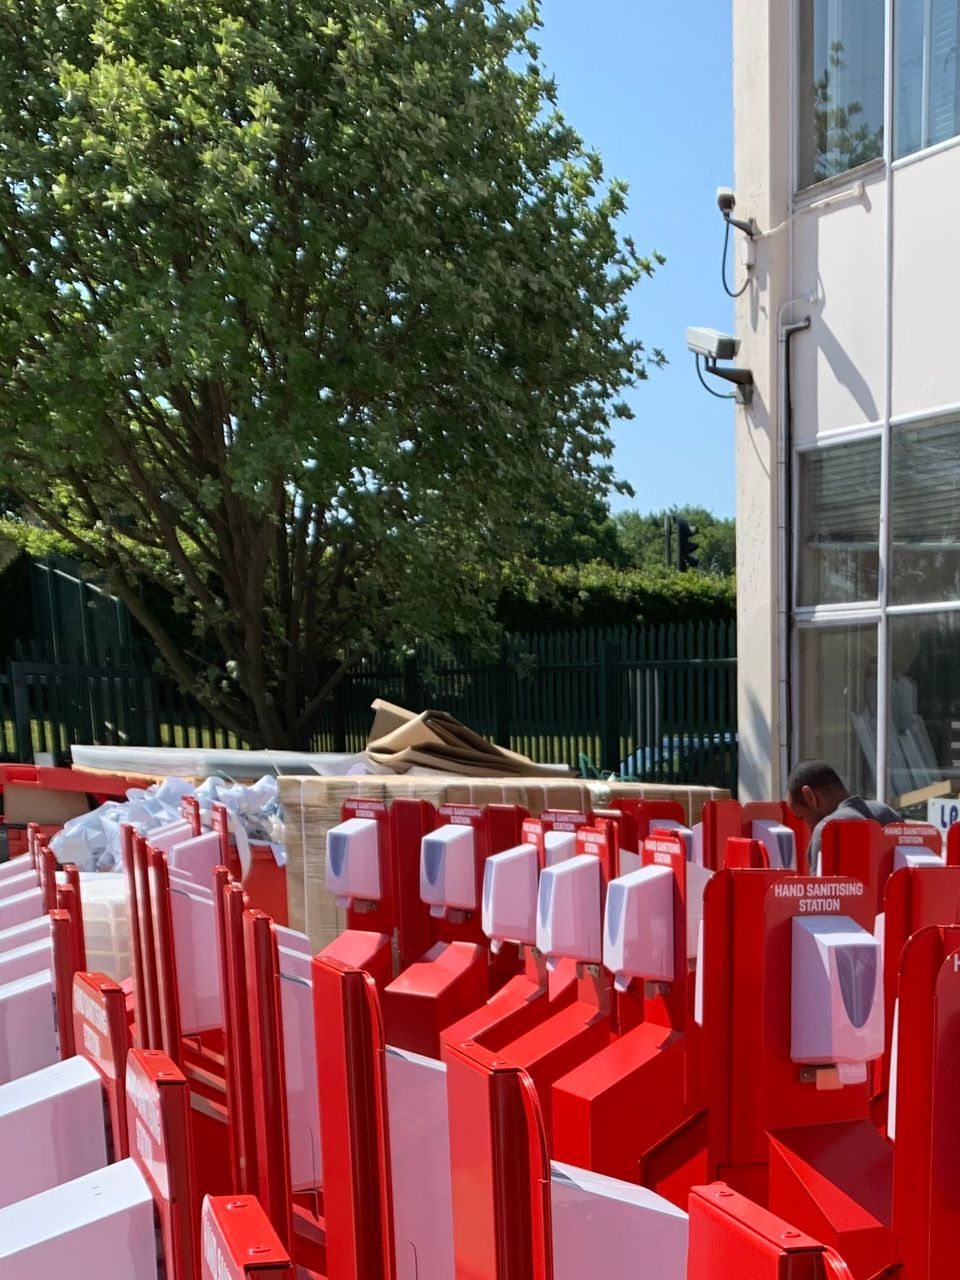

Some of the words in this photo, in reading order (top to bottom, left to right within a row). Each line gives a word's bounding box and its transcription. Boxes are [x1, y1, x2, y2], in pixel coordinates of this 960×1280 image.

[940, 804, 958, 828] LP
[774, 884, 804, 897] HAND
[806, 882, 864, 896] SANITISING
[799, 898, 841, 912] STATION
